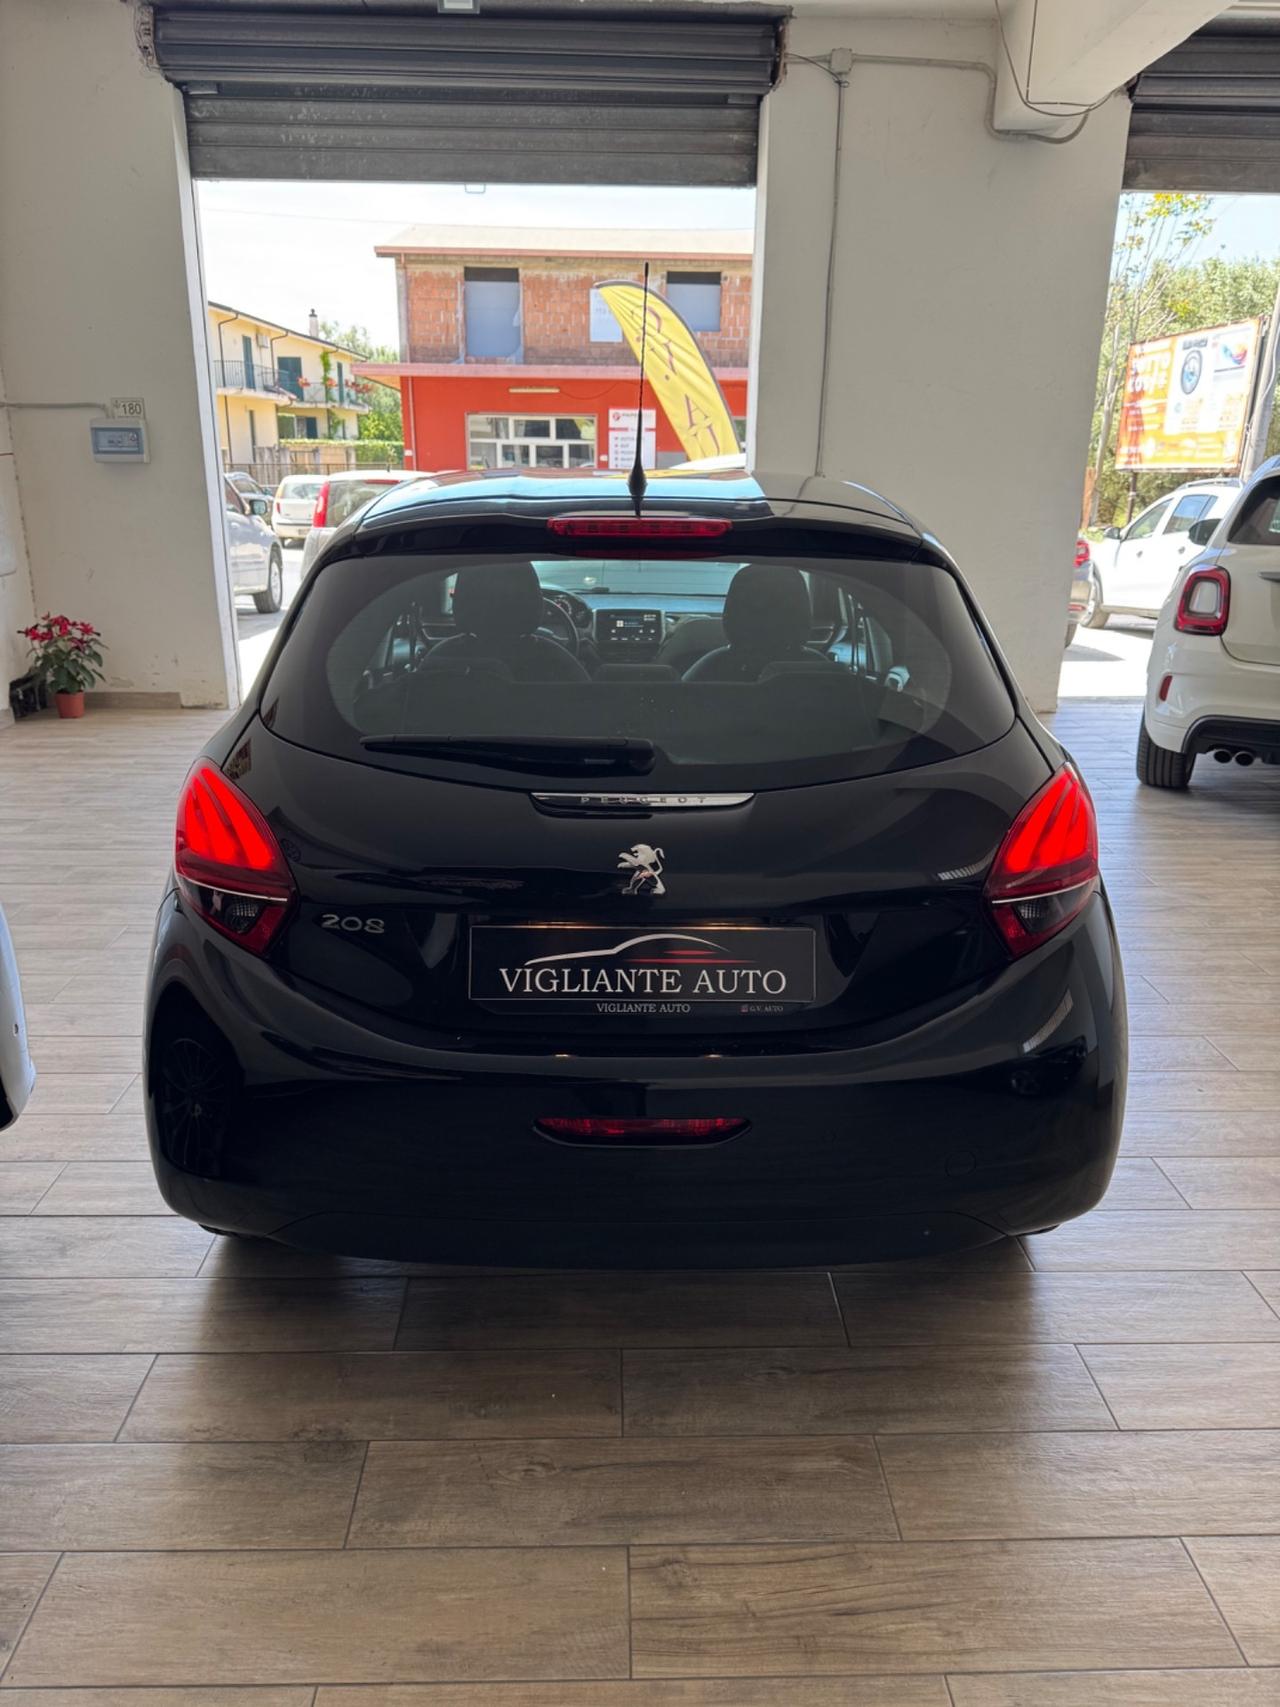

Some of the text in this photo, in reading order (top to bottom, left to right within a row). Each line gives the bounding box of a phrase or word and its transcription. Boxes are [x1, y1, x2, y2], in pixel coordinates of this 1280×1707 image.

[122, 403, 142, 415] 180
[321, 913, 385, 934] 208
[500, 967, 787, 994] VIGLIANTE AUTO
[596, 1002, 691, 1013] VIGLIANTE AUTO
